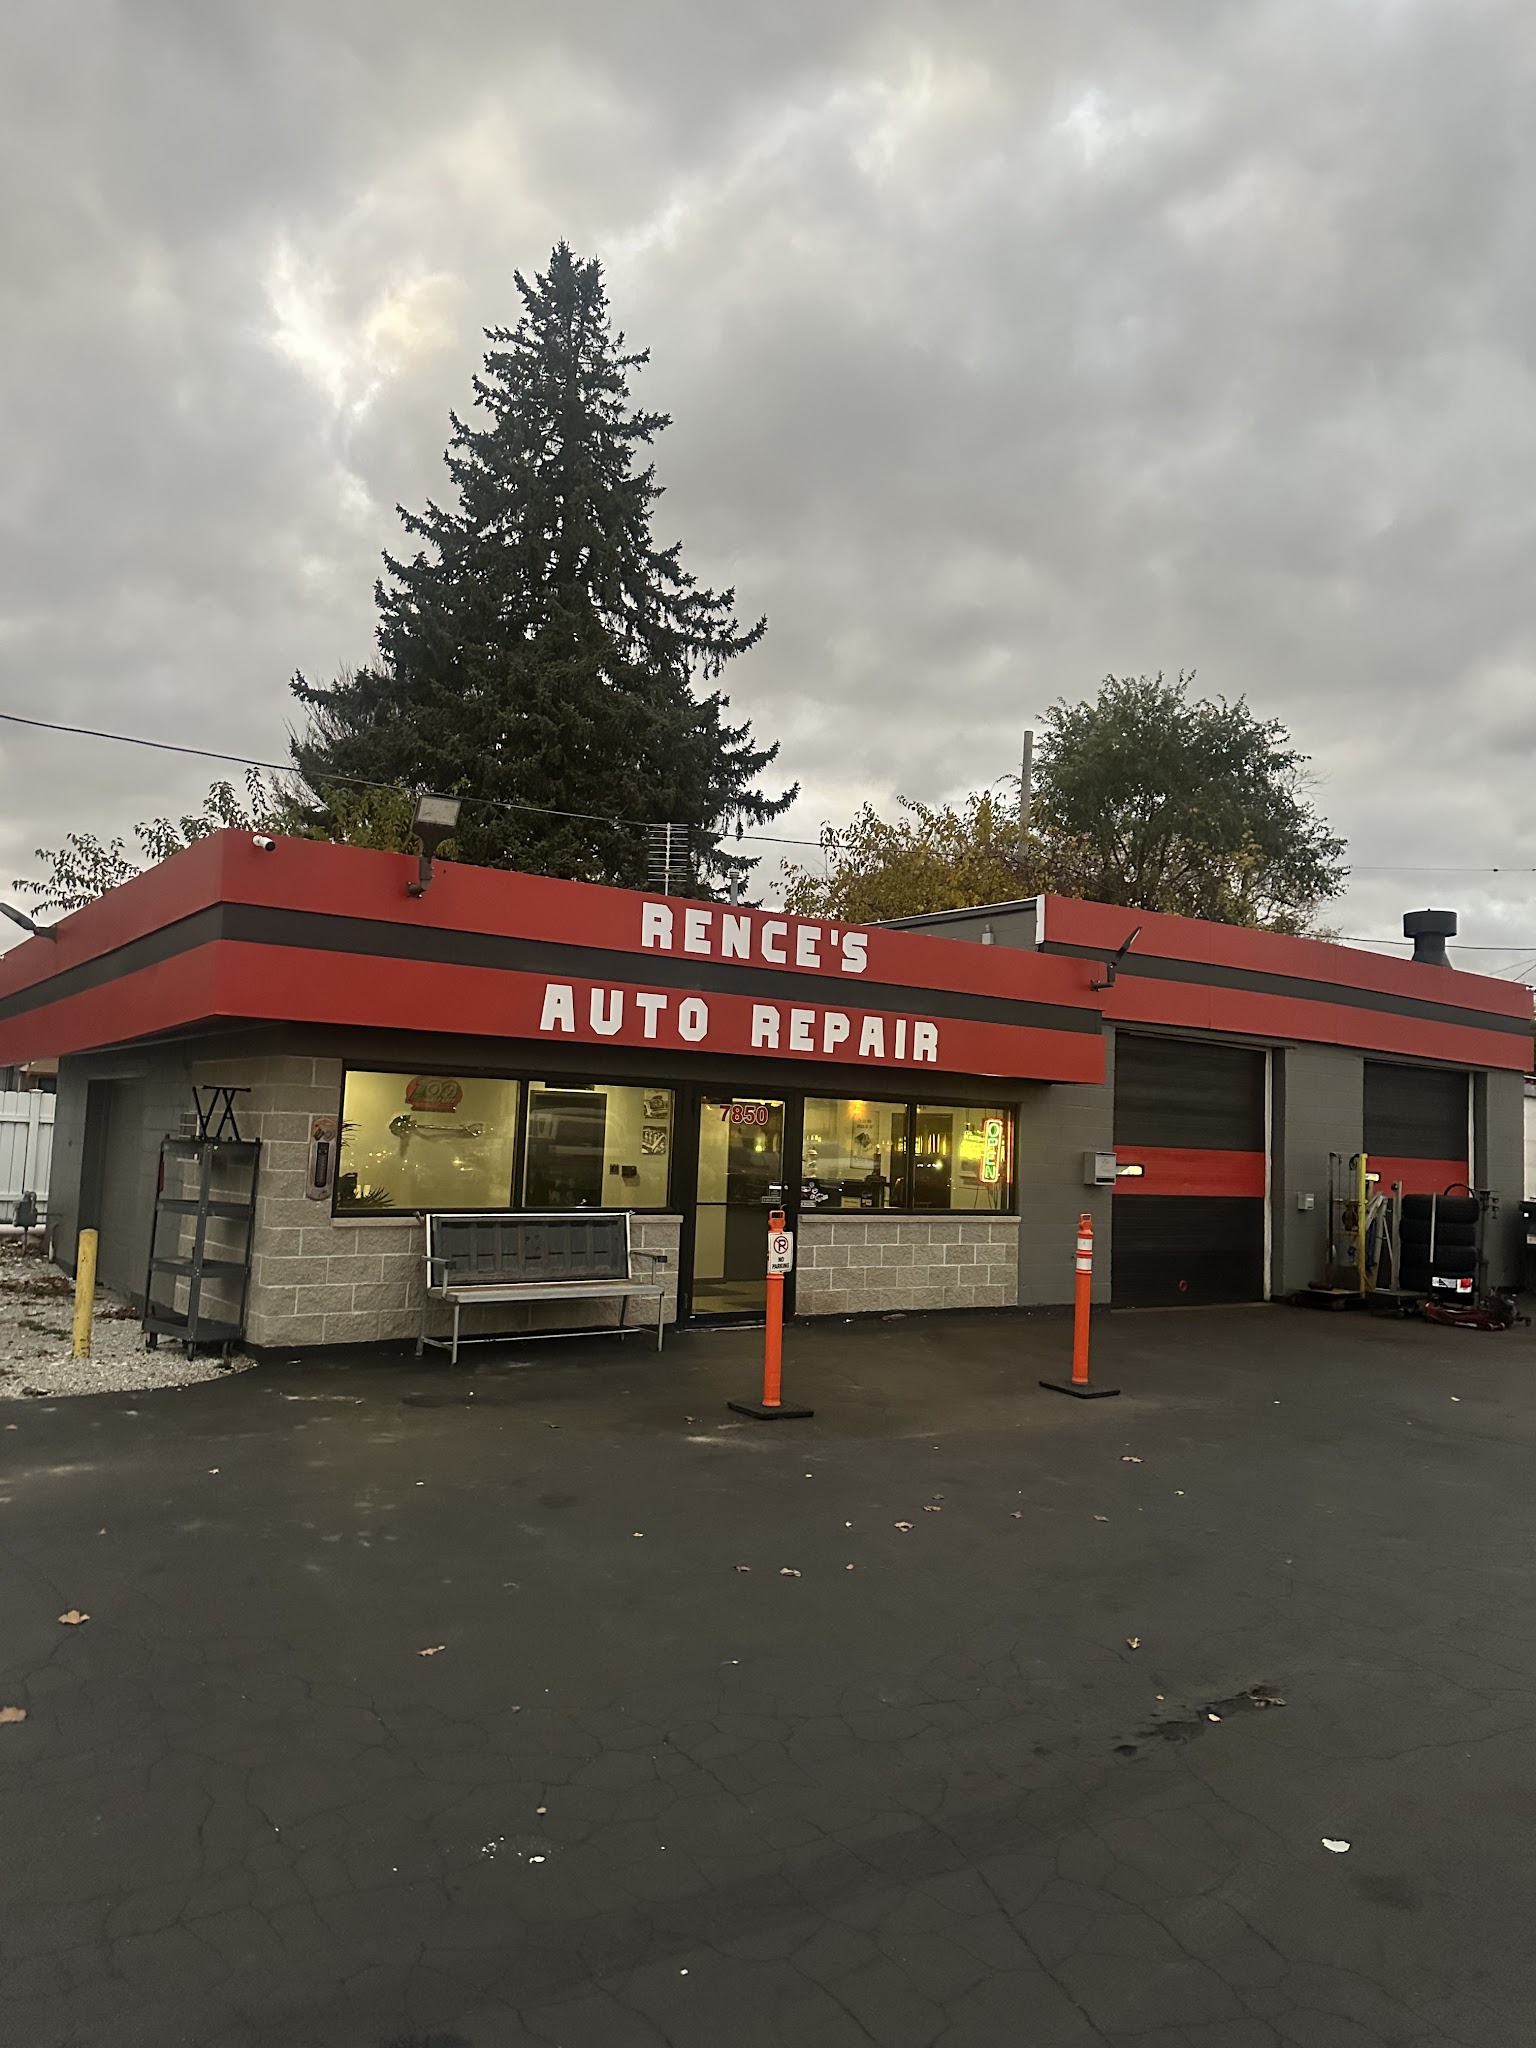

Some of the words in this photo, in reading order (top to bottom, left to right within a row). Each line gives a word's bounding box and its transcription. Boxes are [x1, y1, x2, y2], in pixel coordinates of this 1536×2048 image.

[641, 902, 868, 973] RENCE'S
[540, 984, 708, 1042] AUTO
[751, 1004, 938, 1062] REPAIR
[719, 1104, 768, 1126] 7850
[985, 1123, 1000, 1179] OPEN
